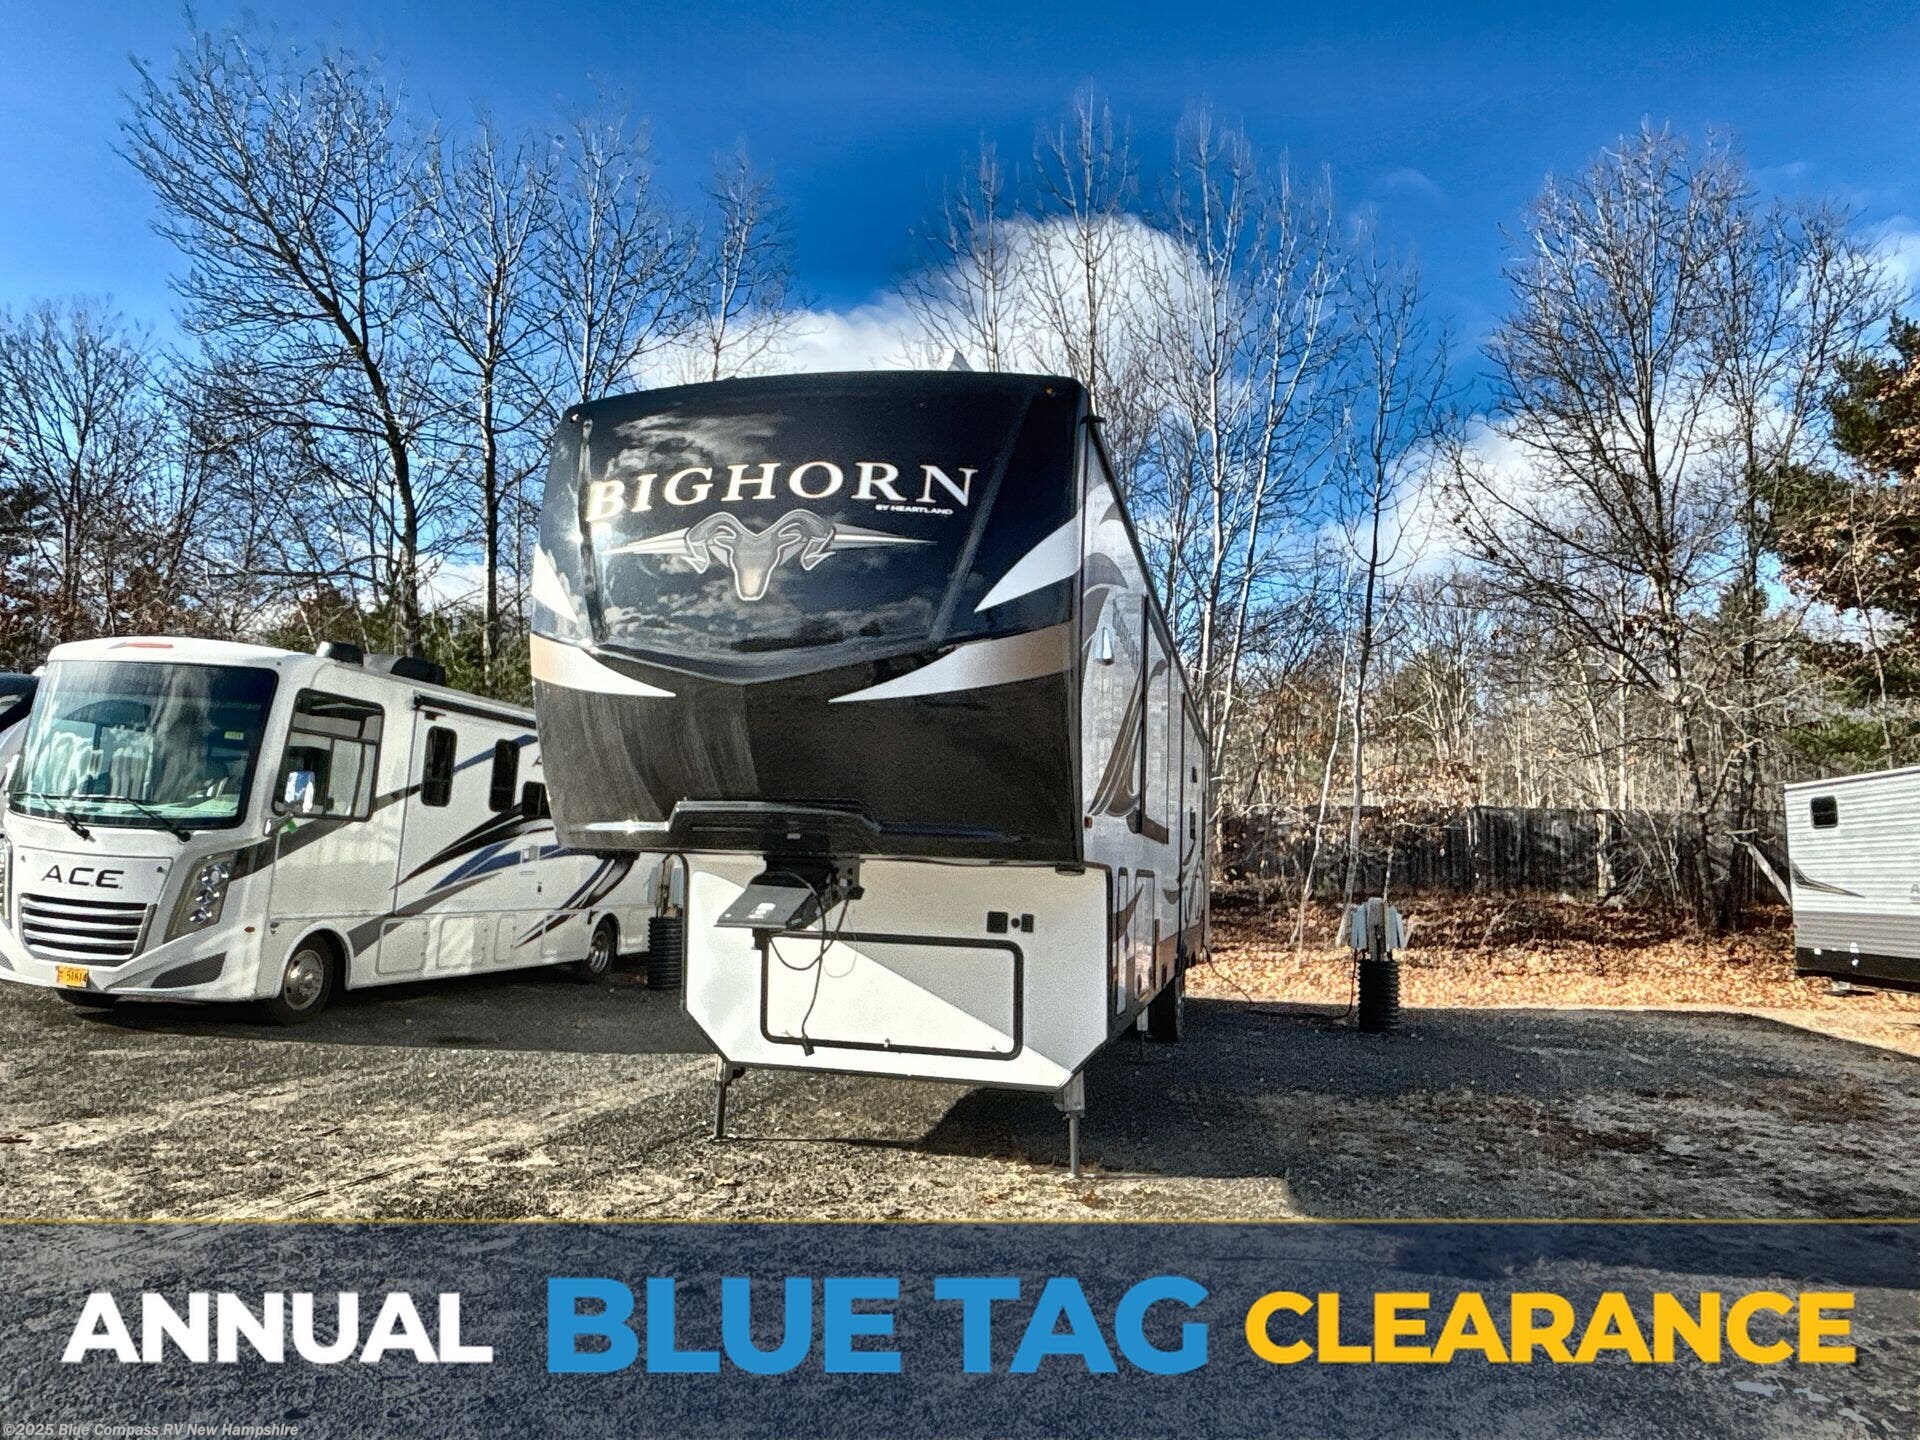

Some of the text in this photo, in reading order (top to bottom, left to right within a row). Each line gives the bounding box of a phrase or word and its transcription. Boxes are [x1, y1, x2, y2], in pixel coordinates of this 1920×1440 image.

[585, 460, 979, 522] BIGHORN
[875, 503, 954, 515] BY HEARTLAND
